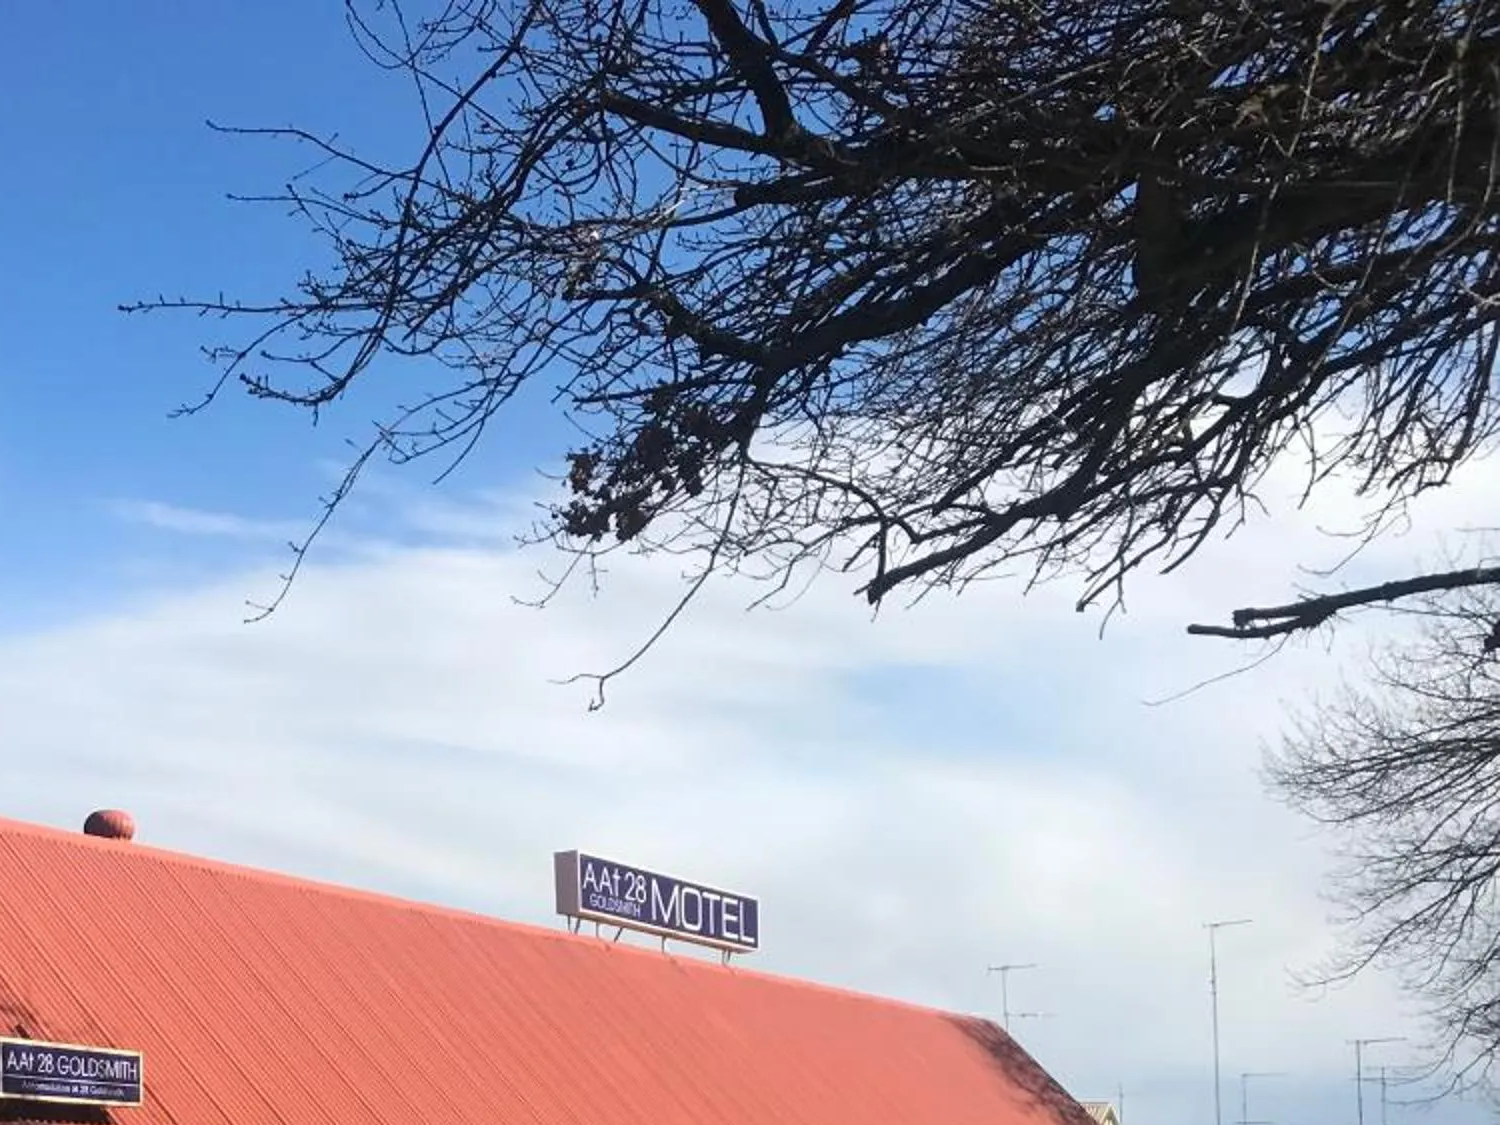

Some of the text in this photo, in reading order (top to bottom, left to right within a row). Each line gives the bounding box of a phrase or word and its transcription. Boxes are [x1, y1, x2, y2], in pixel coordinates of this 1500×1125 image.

[624, 871, 647, 904] 28
[651, 878, 755, 943] MOTEL
[37, 1053, 54, 1074] 28
[56, 1055, 137, 1081] GOLDSMITH
